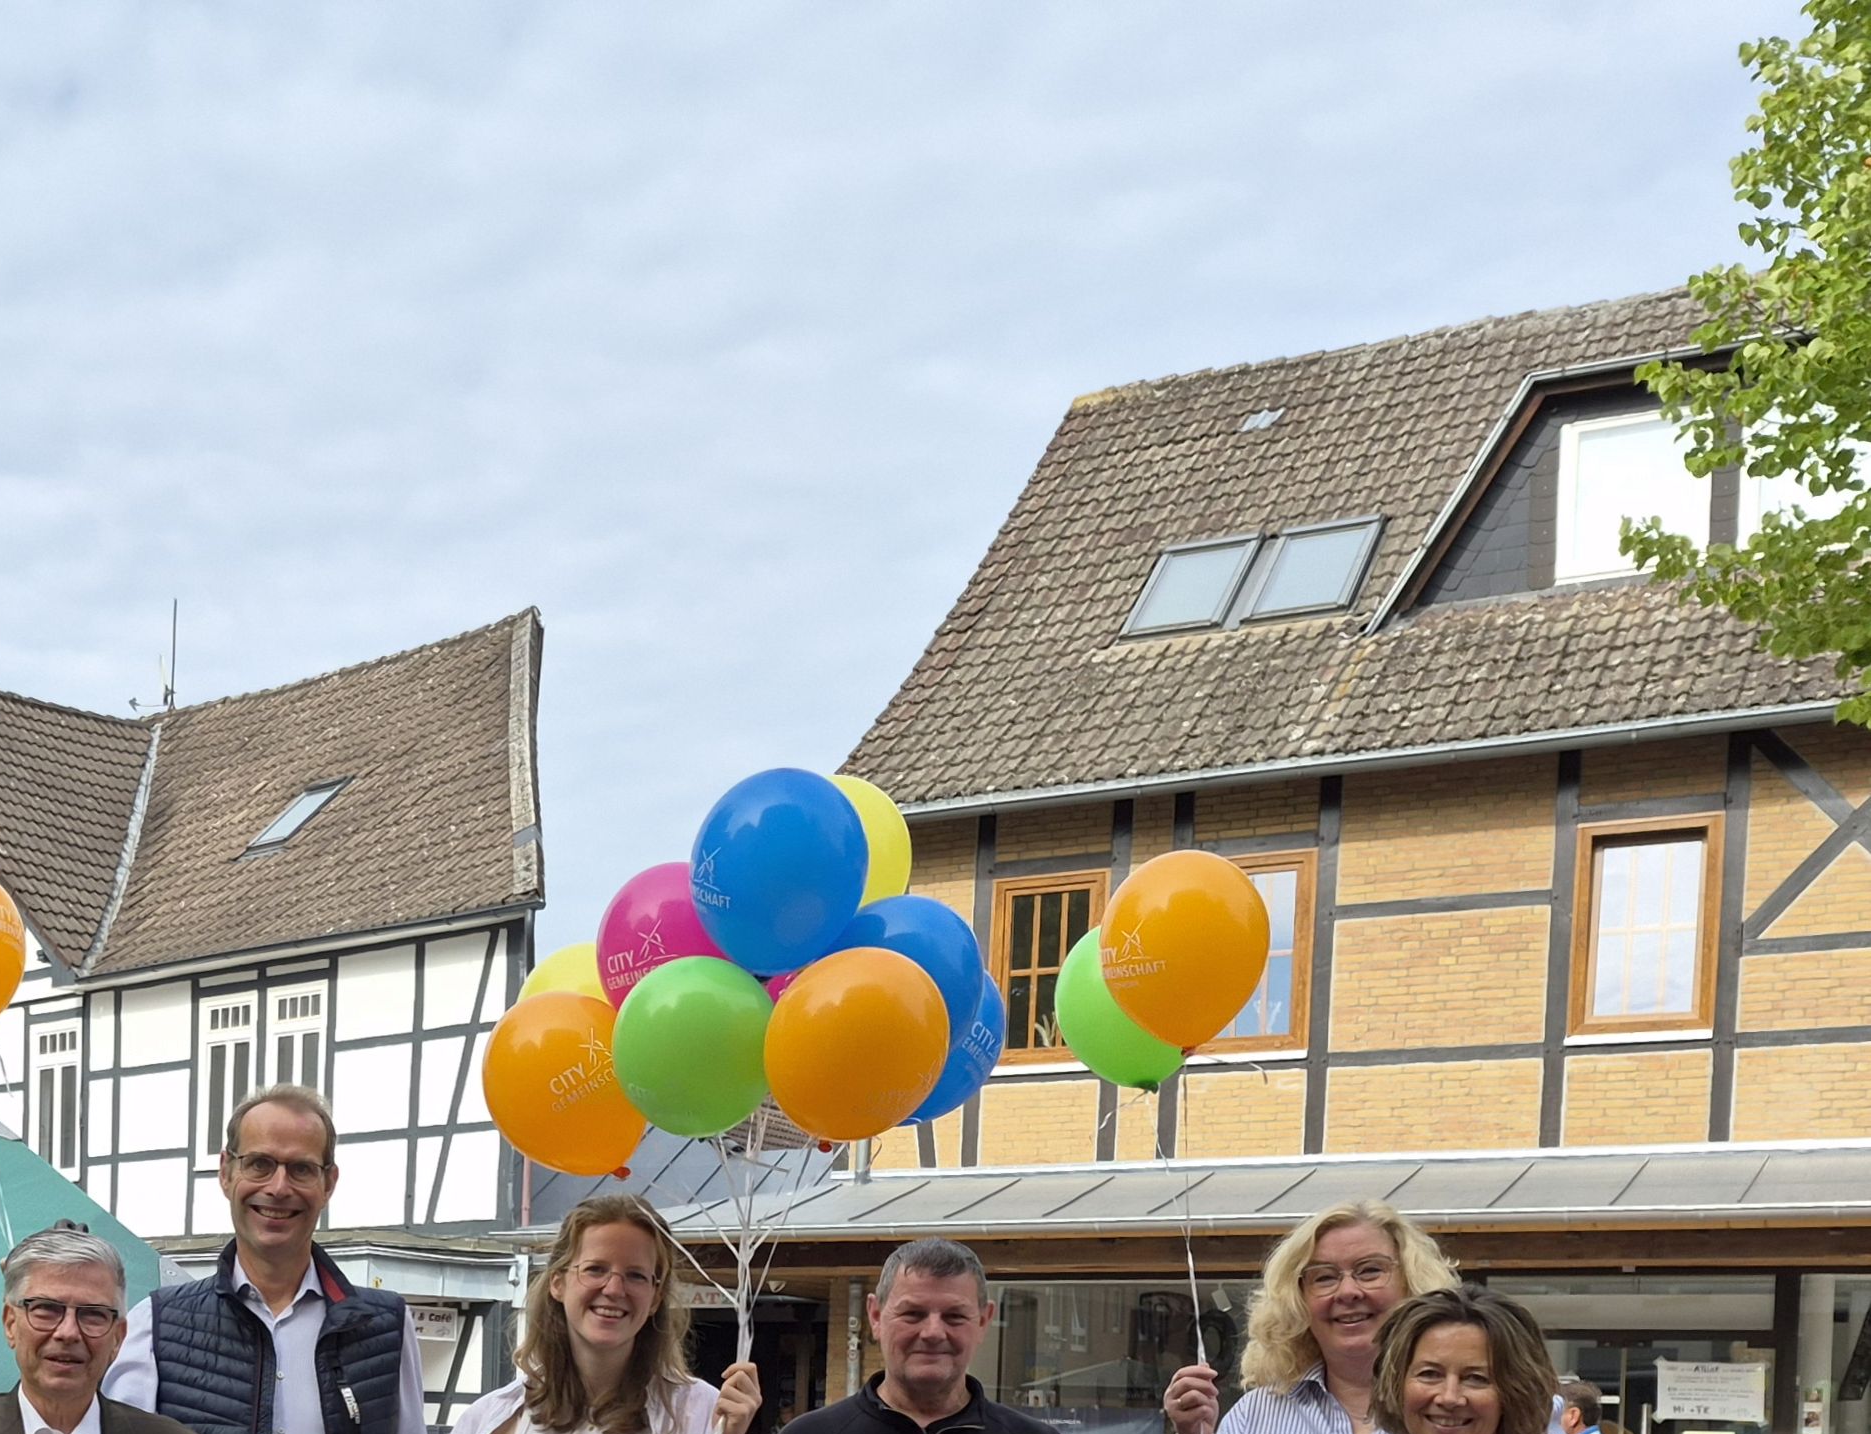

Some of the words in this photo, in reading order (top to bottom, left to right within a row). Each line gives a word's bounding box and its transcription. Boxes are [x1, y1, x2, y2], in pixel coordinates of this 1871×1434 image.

[608, 950, 634, 974] CITY
[971, 1021, 996, 1052] CITY
[550, 1062, 586, 1095] CITY
[552, 1067, 617, 1113] GEMEINSC
